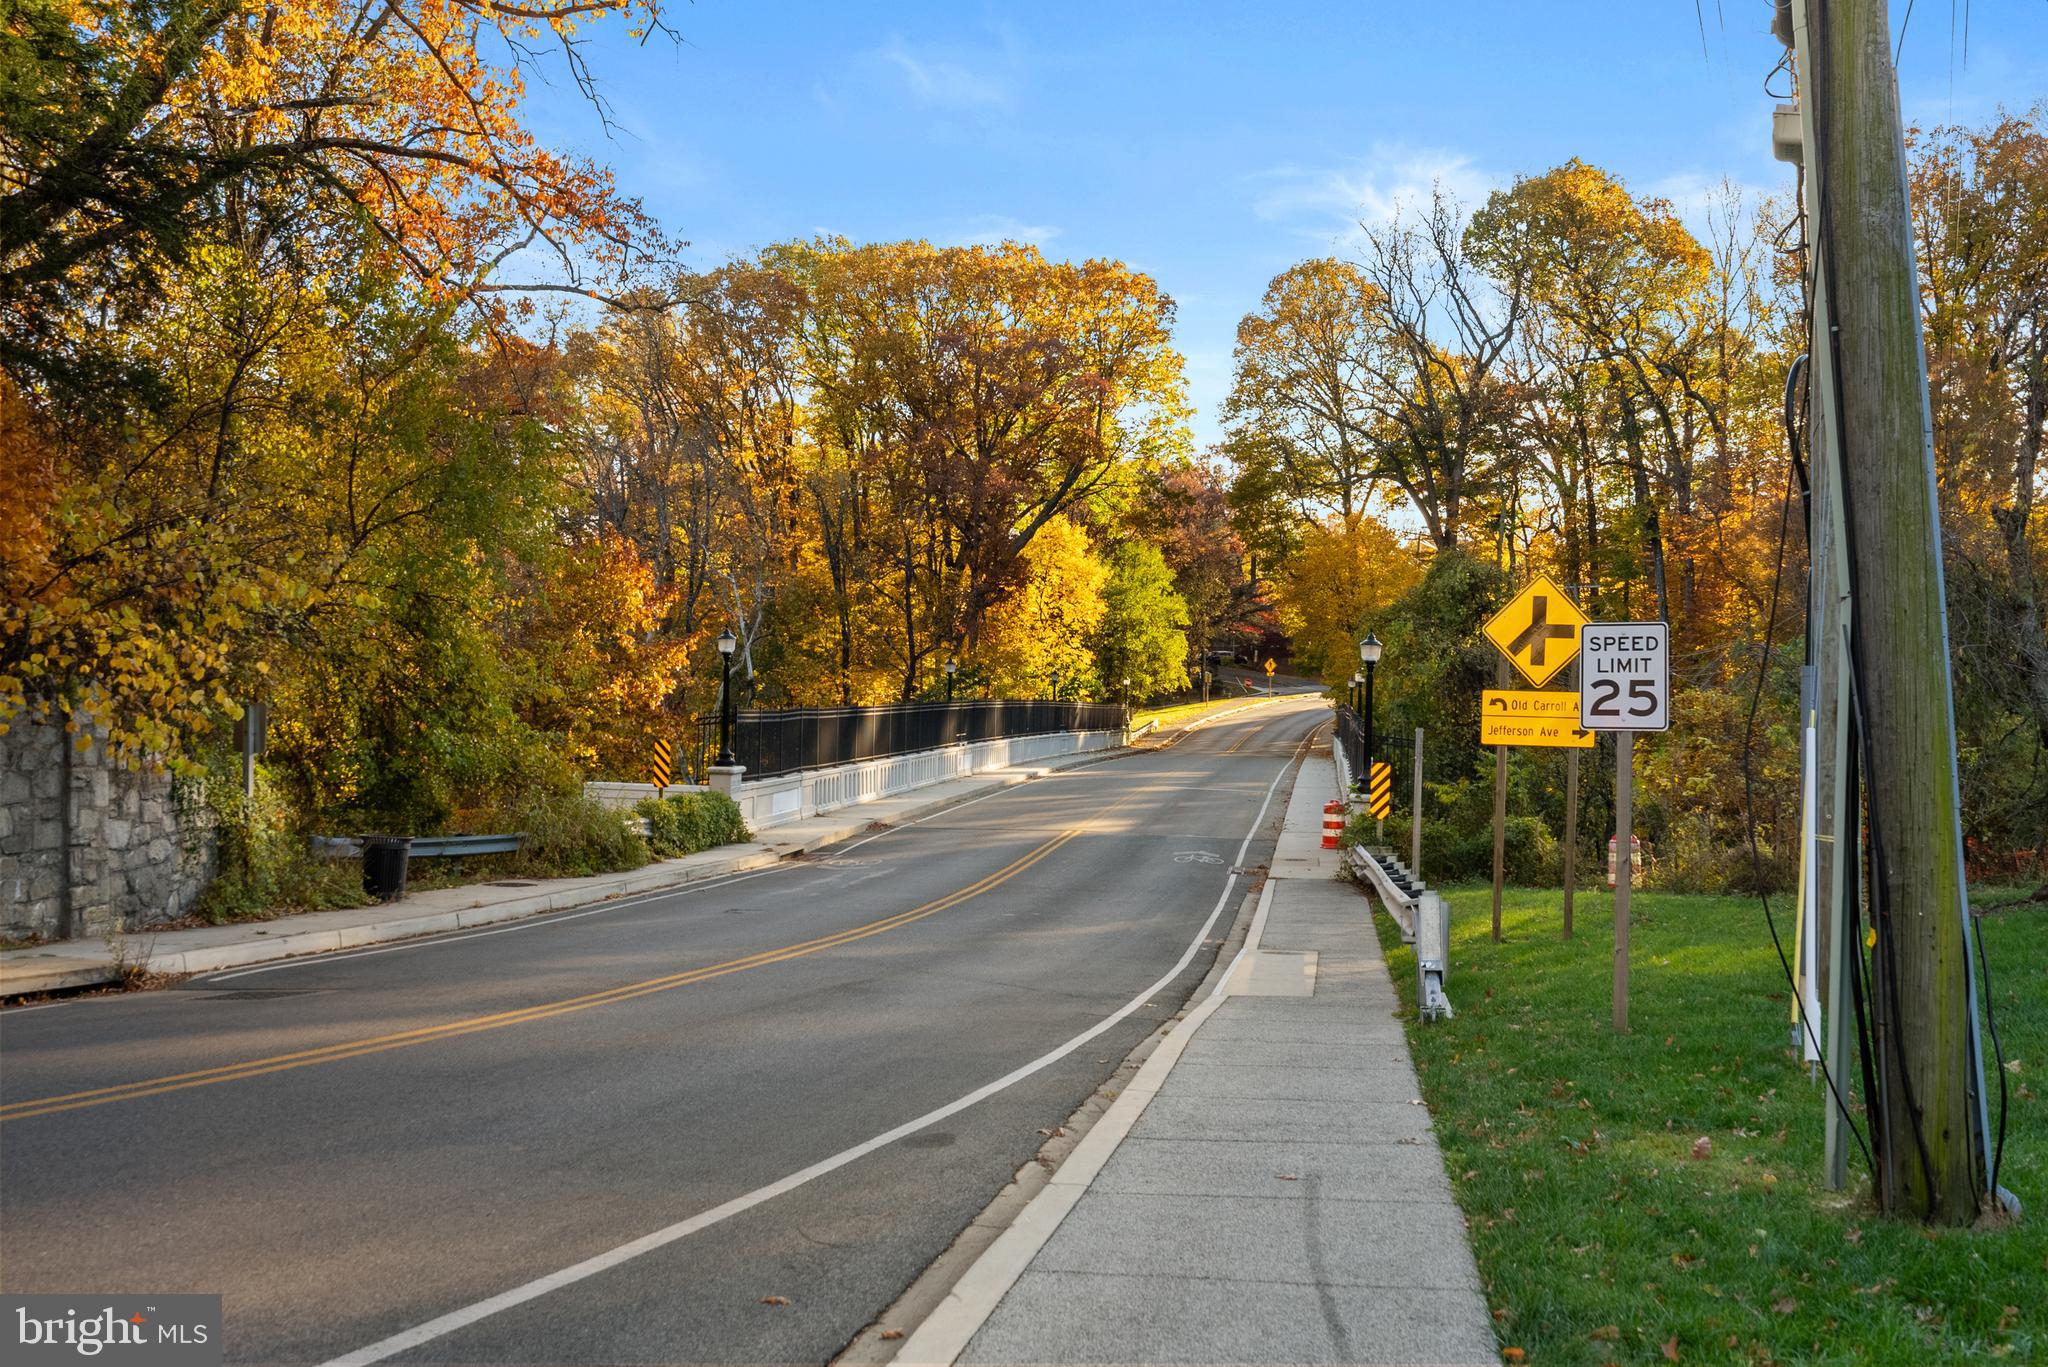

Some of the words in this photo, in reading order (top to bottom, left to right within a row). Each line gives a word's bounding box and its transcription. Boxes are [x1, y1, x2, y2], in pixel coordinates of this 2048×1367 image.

[1589, 636, 1659, 652] SPEED
[1597, 657, 1652, 673] LIMIT
[1511, 699, 1528, 711] Old
[1533, 700, 1567, 712] Carroll
[1572, 701, 1580, 712] A
[1589, 679, 1659, 717] 25
[1487, 725, 1534, 737] Jefferson
[1539, 726, 1559, 738] Ave
